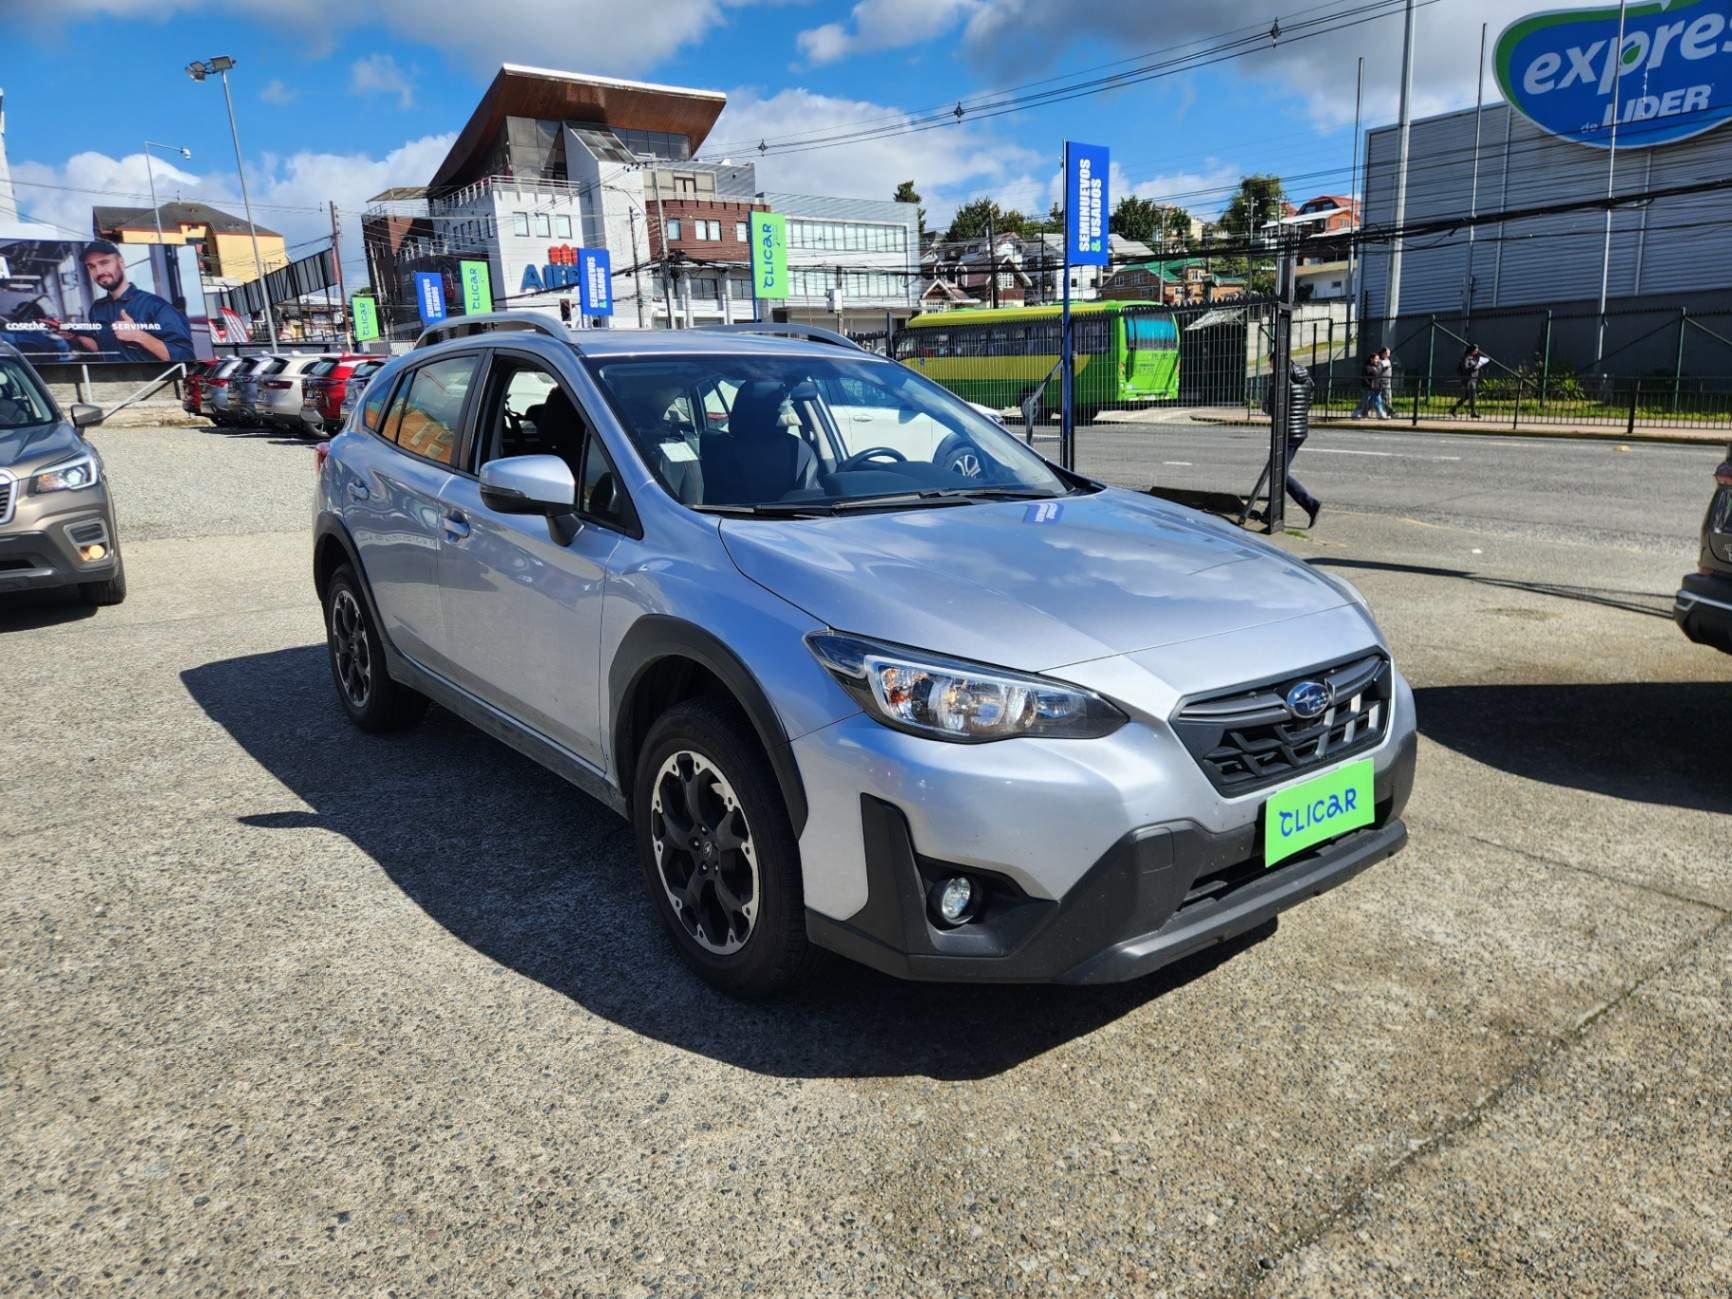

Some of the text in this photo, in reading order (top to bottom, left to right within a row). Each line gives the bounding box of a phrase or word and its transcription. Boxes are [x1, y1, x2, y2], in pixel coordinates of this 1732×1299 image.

[1523, 13, 1732, 95] expre
[1602, 84, 1712, 127] LIDER
[1079, 158, 1091, 252] SEMINUEVOS
[1090, 178, 1102, 238] USADOS
